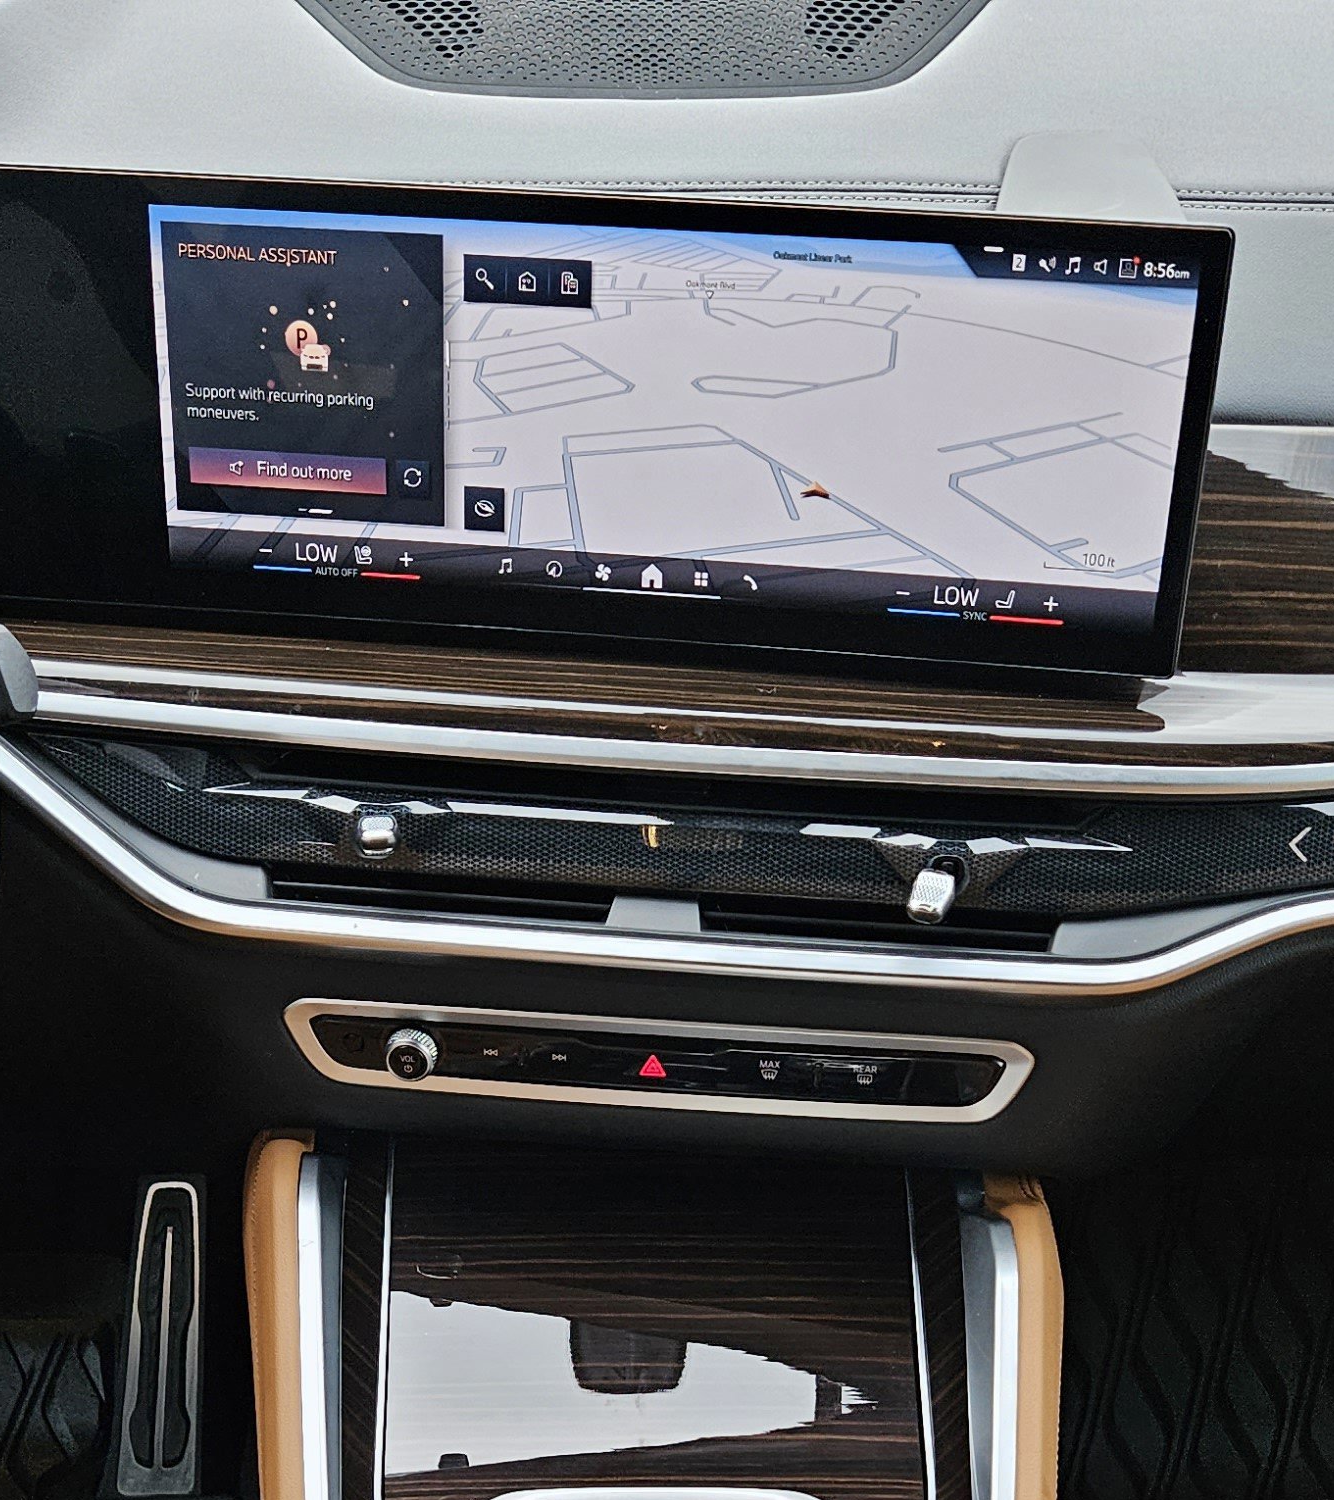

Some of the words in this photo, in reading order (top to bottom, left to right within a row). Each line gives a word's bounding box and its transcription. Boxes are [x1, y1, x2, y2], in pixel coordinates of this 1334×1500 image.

[178, 242, 256, 262] PERSONAL
[258, 247, 338, 265] ASSISTANT
[185, 383, 236, 400] Support
[238, 386, 266, 401] with
[268, 389, 324, 408] recurring
[326, 392, 375, 411] parking
[186, 405, 260, 422] maneuvers.
[256, 460, 288, 477] Find
[290, 463, 315, 479] out
[316, 467, 353, 482] more
[294, 541, 339, 564] LOW
[1081, 552, 1105, 568] 100
[1106, 556, 1116, 568] ft
[314, 566, 340, 577] AUTO
[340, 568, 360, 578] OFF
[933, 584, 980, 607] LOW
[962, 610, 988, 622] SYNC
[399, 1054, 417, 1064] VOL
[758, 1059, 782, 1070] MAX
[852, 1063, 878, 1075] REAR
